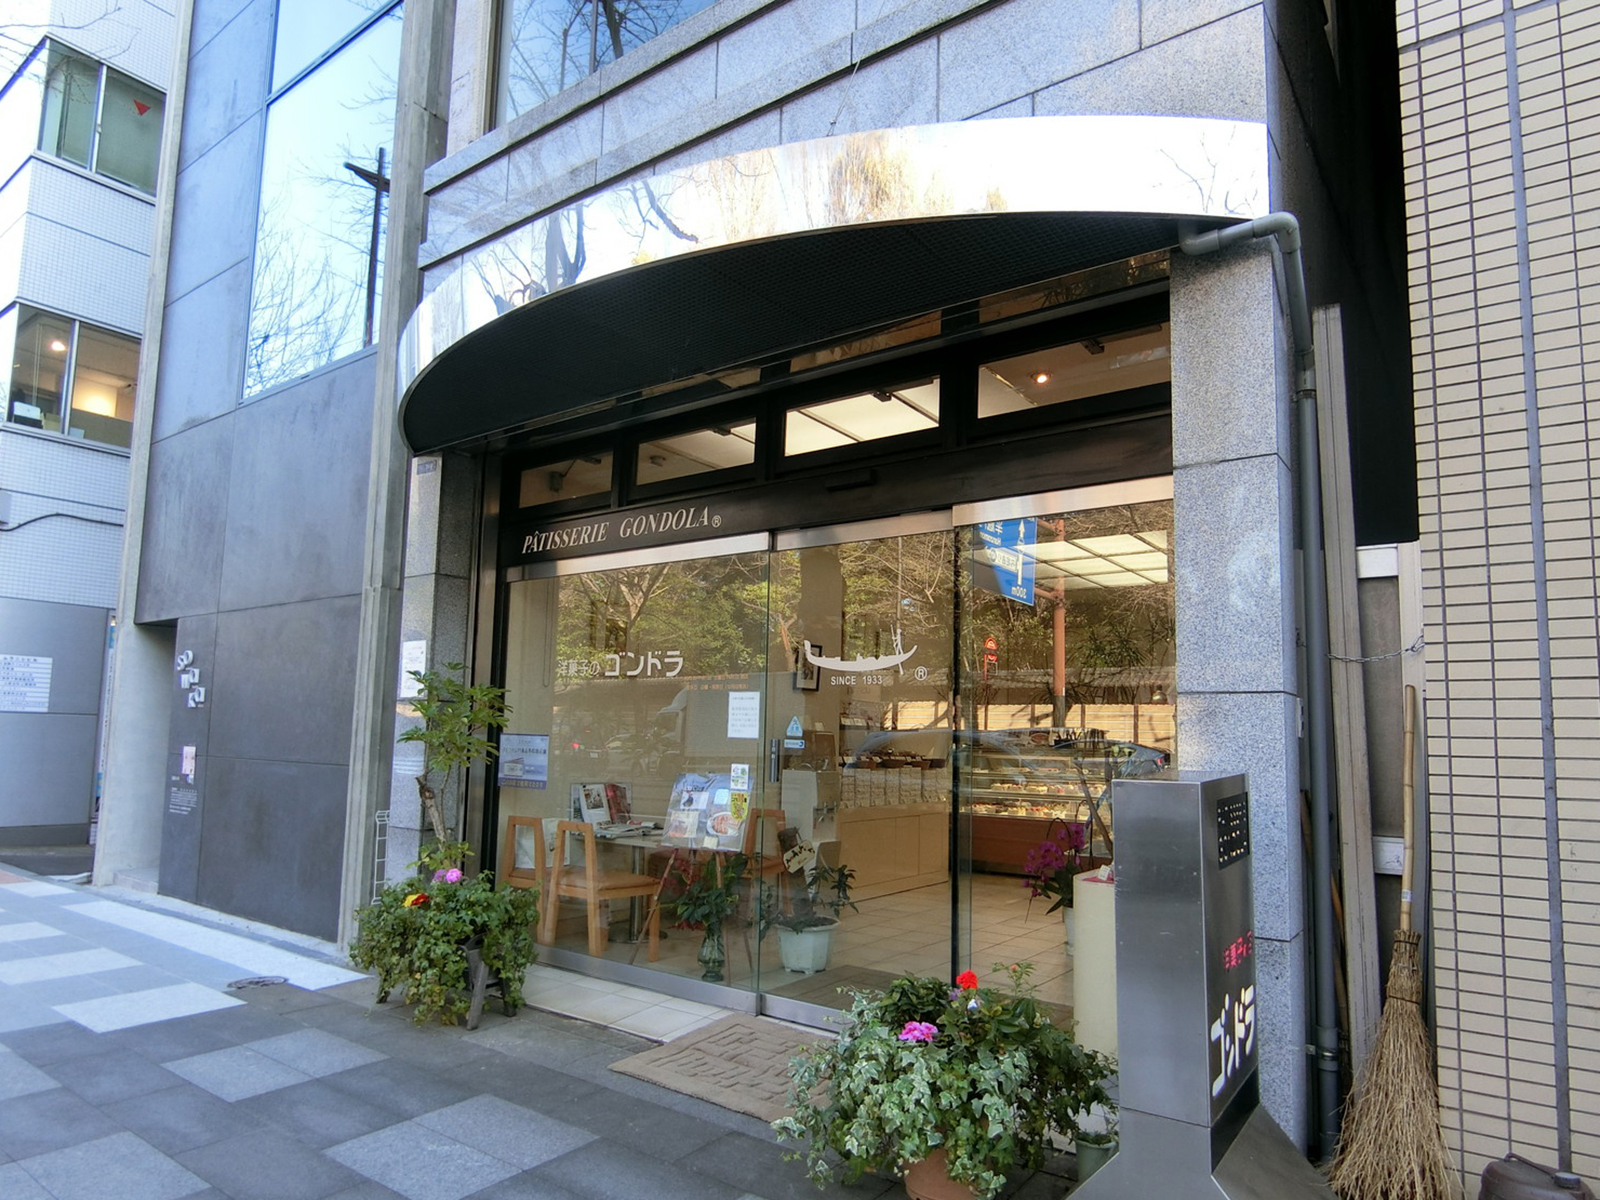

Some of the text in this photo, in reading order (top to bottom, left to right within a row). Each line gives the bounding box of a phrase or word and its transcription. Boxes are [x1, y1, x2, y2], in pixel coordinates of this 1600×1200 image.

[522, 521, 610, 554] PÂTISSERIE
[620, 506, 709, 538] GONDOLA
[830, 675, 857, 686] SINCE
[862, 675, 883, 685] 1933
[1210, 984, 1256, 1098] ゴンドラ
